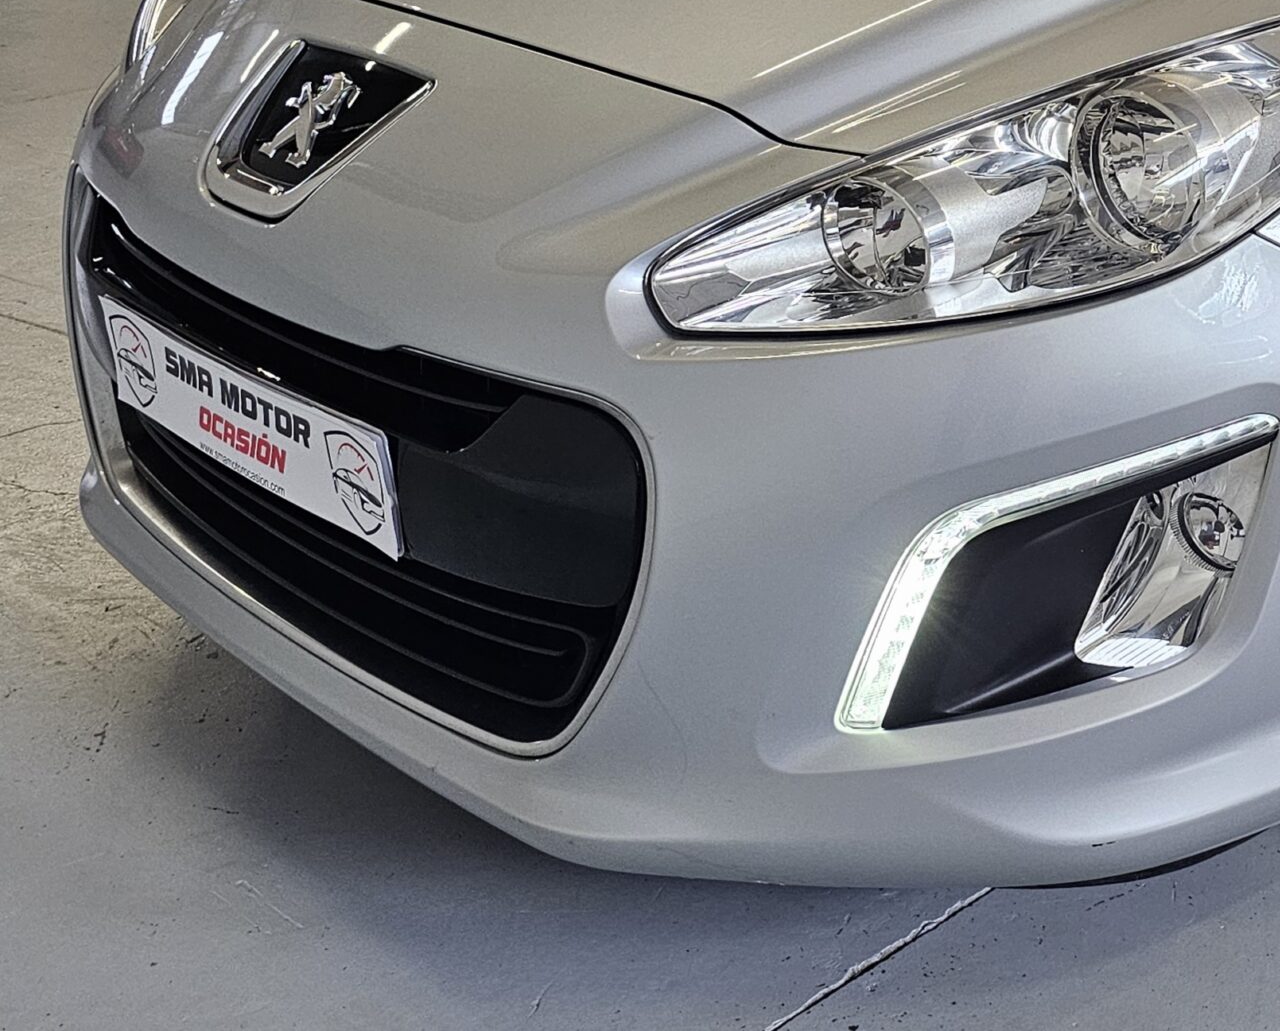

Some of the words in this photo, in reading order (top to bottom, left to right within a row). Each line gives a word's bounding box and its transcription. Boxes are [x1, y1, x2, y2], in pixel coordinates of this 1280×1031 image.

[164, 346, 214, 398] SMA
[219, 377, 310, 449] MOTOR
[199, 406, 286, 474] OCASIÓN
